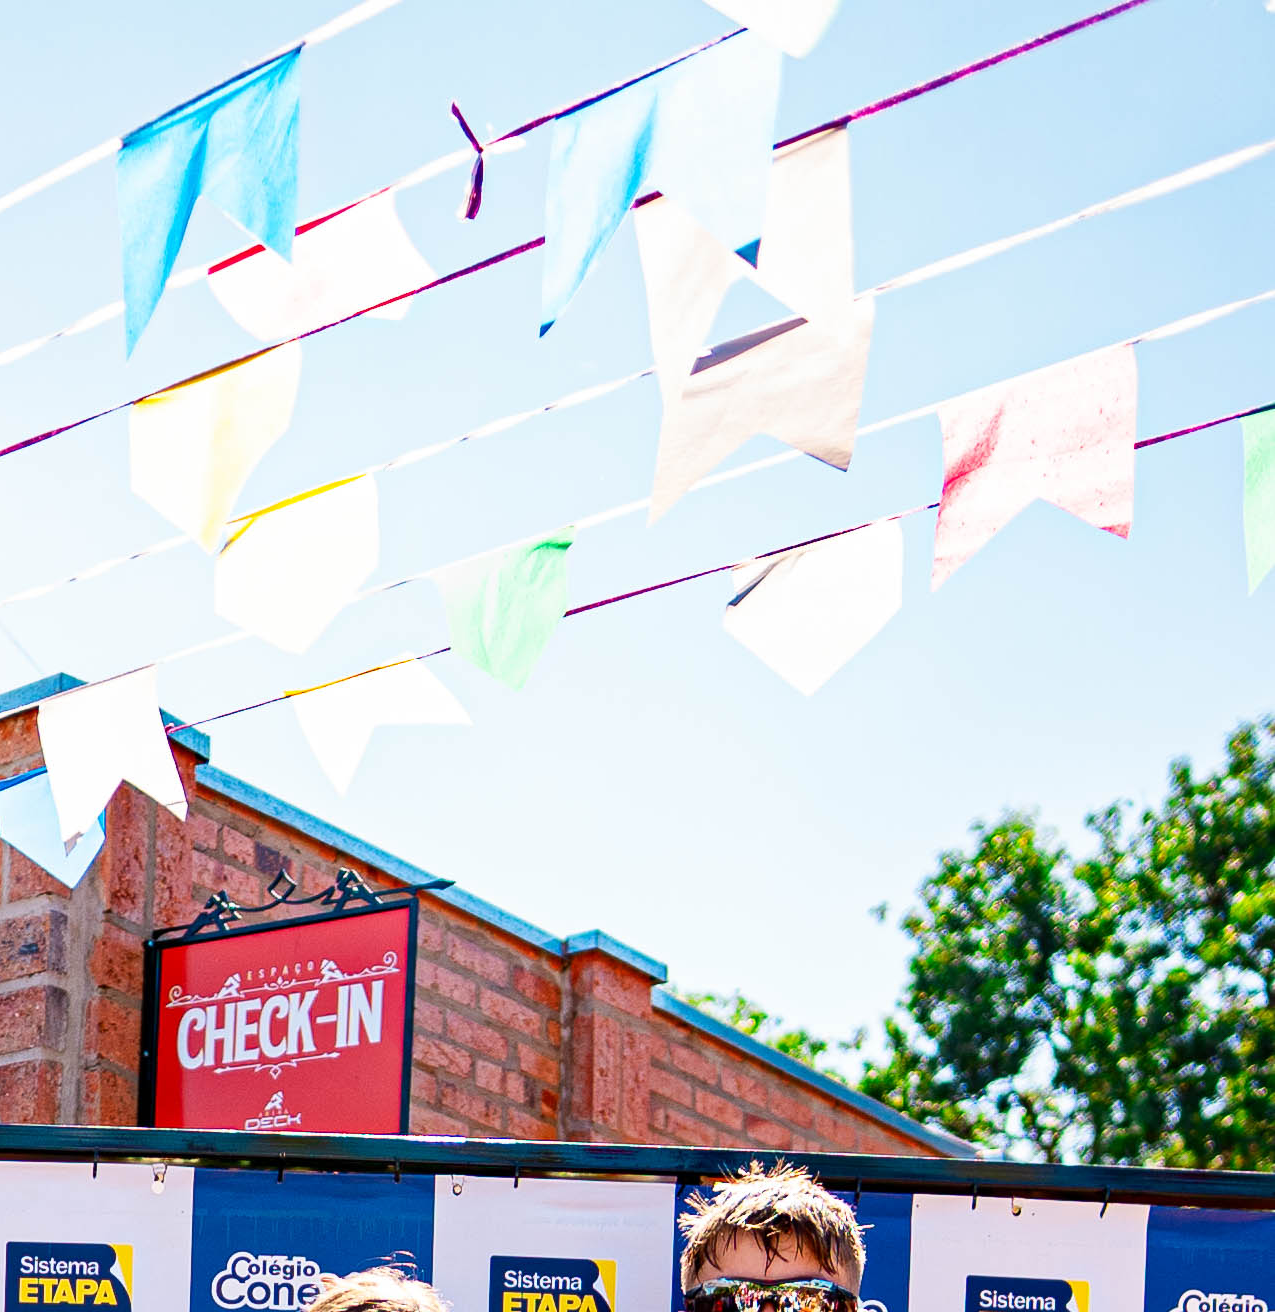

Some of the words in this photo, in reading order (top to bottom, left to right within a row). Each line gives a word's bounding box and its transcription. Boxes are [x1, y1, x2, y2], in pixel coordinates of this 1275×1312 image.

[246, 960, 314, 981] ESPAÇO
[177, 979, 384, 1070] CHECK-IN
[244, 1112, 302, 1131] DECK
[20, 1256, 99, 1276] Sistema
[231, 1257, 315, 1280] Colégio
[216, 1274, 322, 1307] Cone
[504, 1270, 582, 1291] Sistema
[19, 1278, 118, 1306] ETAPA
[980, 1290, 1056, 1311] Sistema
